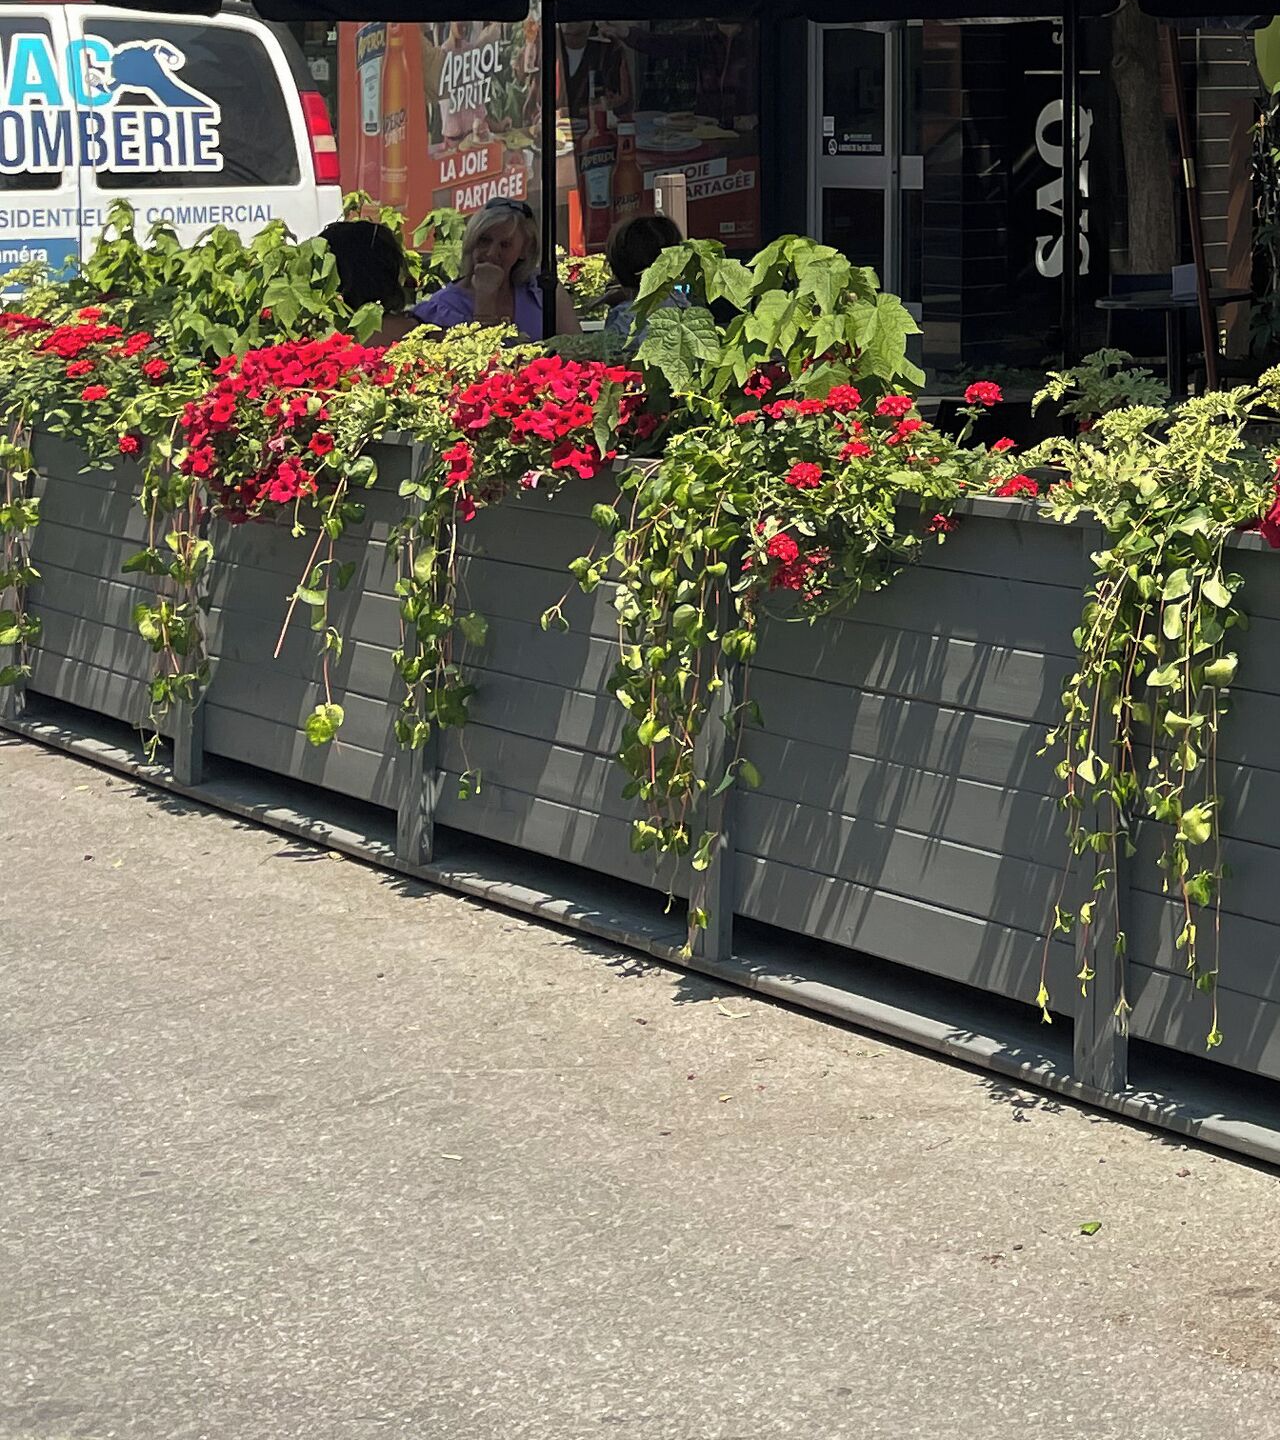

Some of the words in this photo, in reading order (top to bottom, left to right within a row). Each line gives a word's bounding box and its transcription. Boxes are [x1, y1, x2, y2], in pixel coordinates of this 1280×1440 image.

[438, 40, 504, 97] APEROL
[440, 160, 457, 184] LA
[458, 148, 489, 179] JOIE
[686, 168, 751, 200] ARTAGÉE
[455, 167, 524, 211] PARTAGÉE
[146, 204, 276, 224] COMMERCIAL
